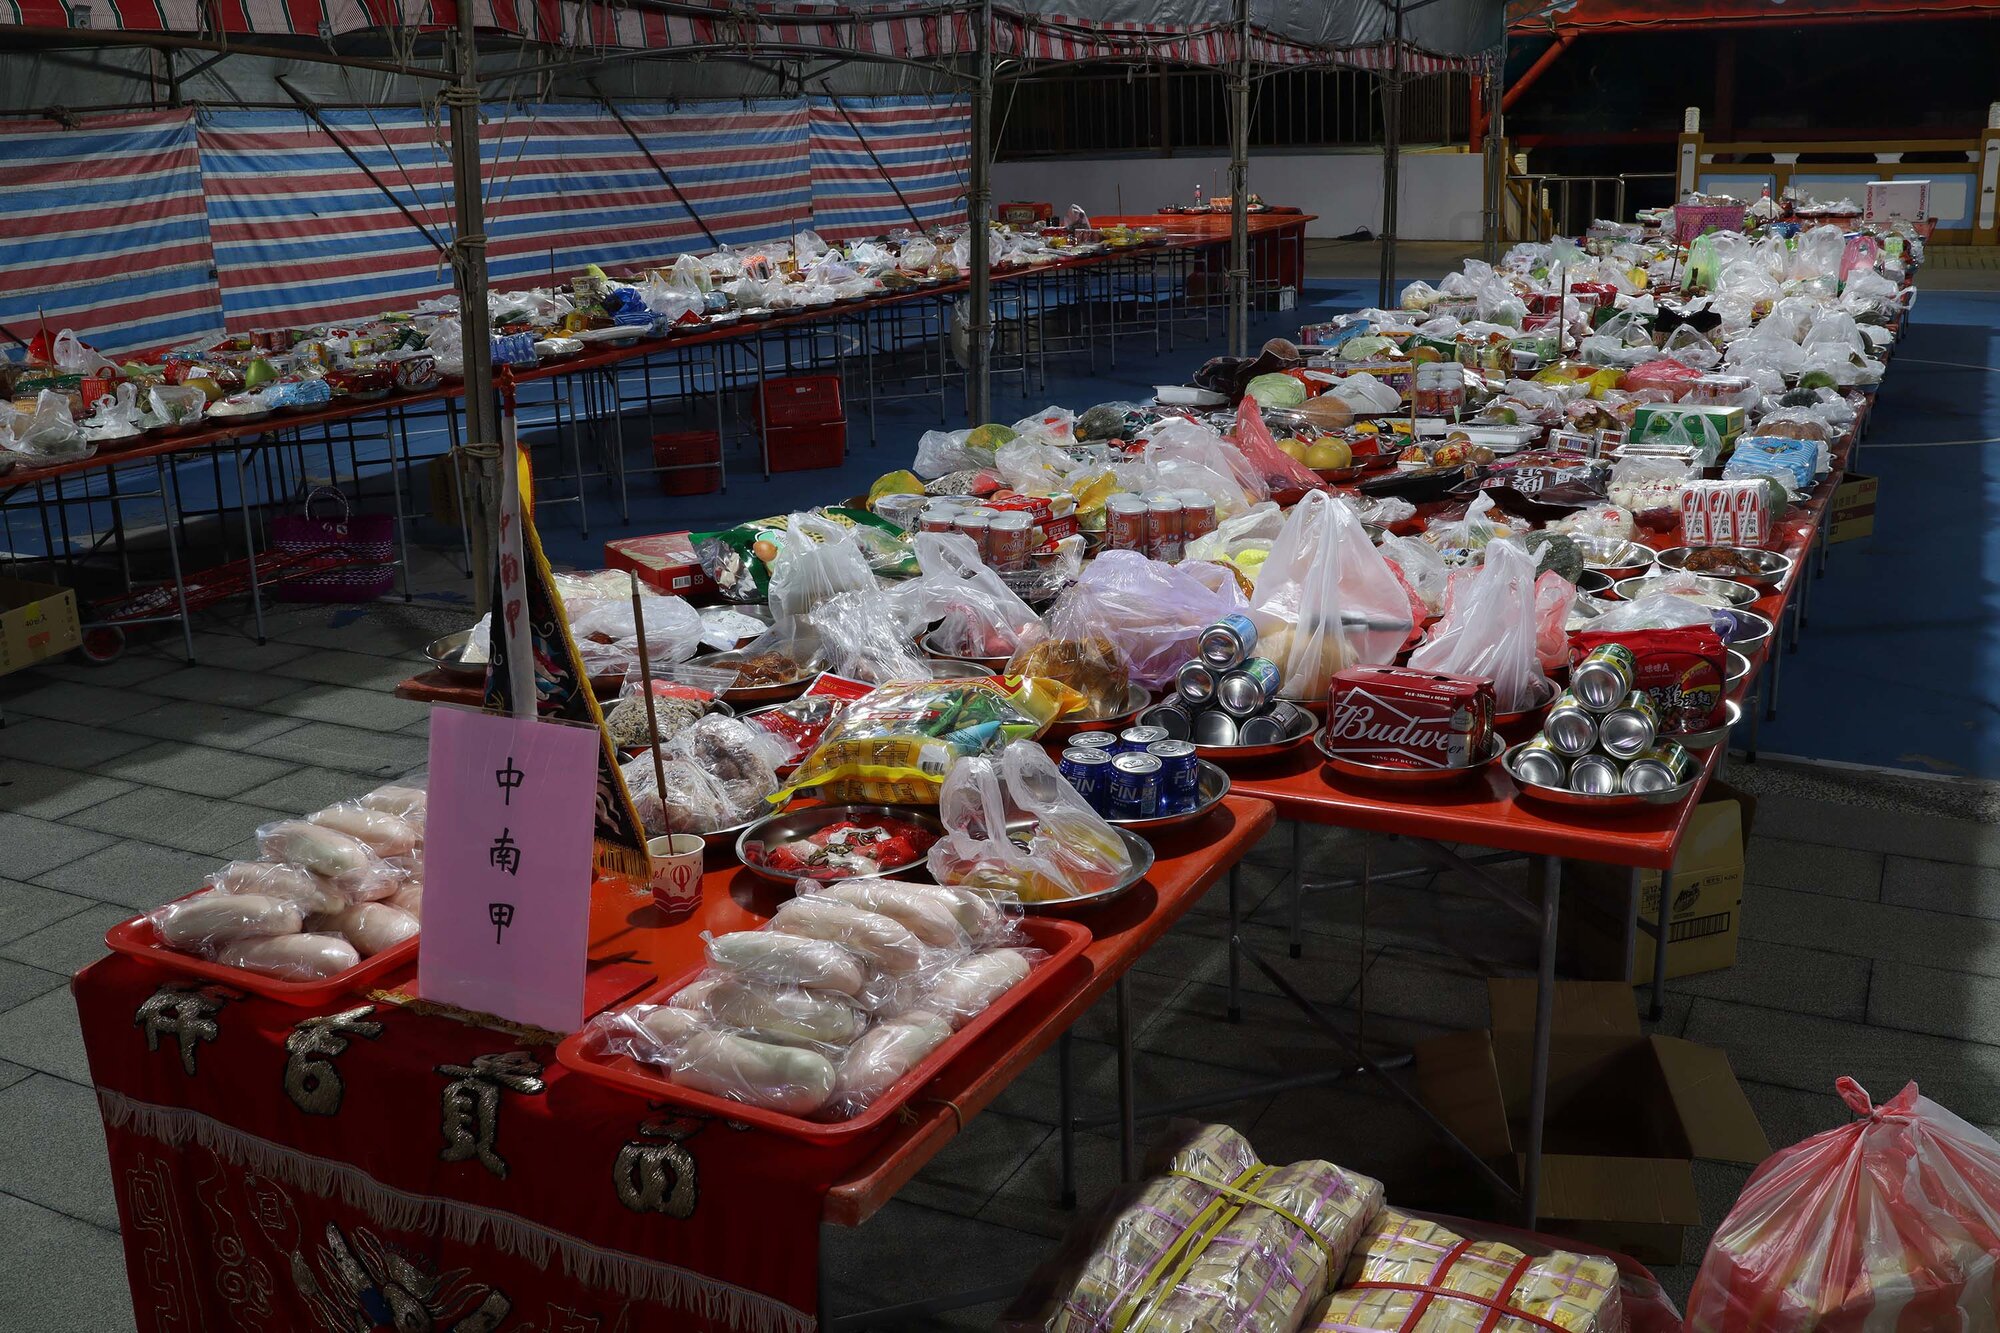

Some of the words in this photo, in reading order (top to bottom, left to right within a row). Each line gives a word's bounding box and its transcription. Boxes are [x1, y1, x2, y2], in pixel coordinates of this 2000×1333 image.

[1173, 766, 1199, 785] FIN
[1109, 782, 1138, 801] FIN
[488, 756, 524, 945] 中南甲
